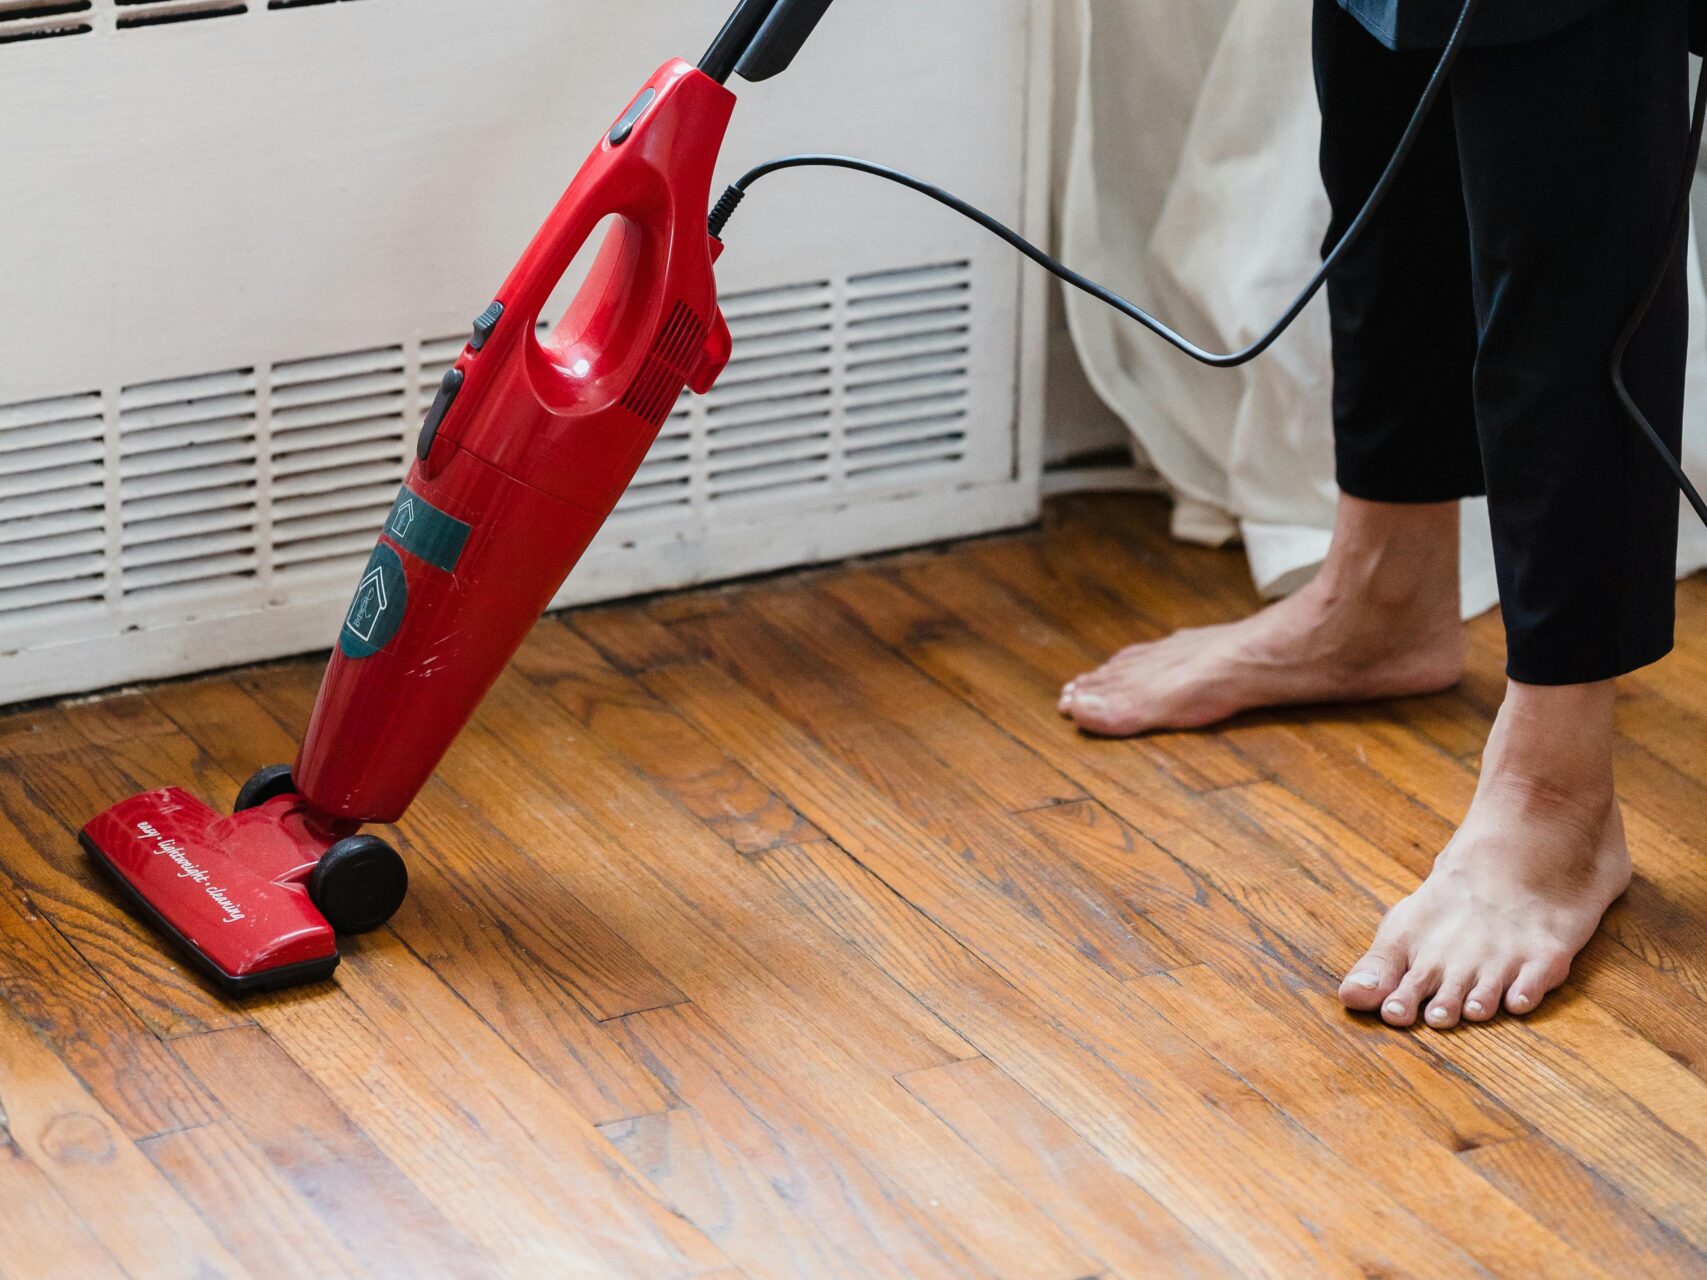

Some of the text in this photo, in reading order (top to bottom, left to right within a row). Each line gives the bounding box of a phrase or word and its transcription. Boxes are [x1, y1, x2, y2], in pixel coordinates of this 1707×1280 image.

[137, 821, 246, 923] easy lightweight cleaning
